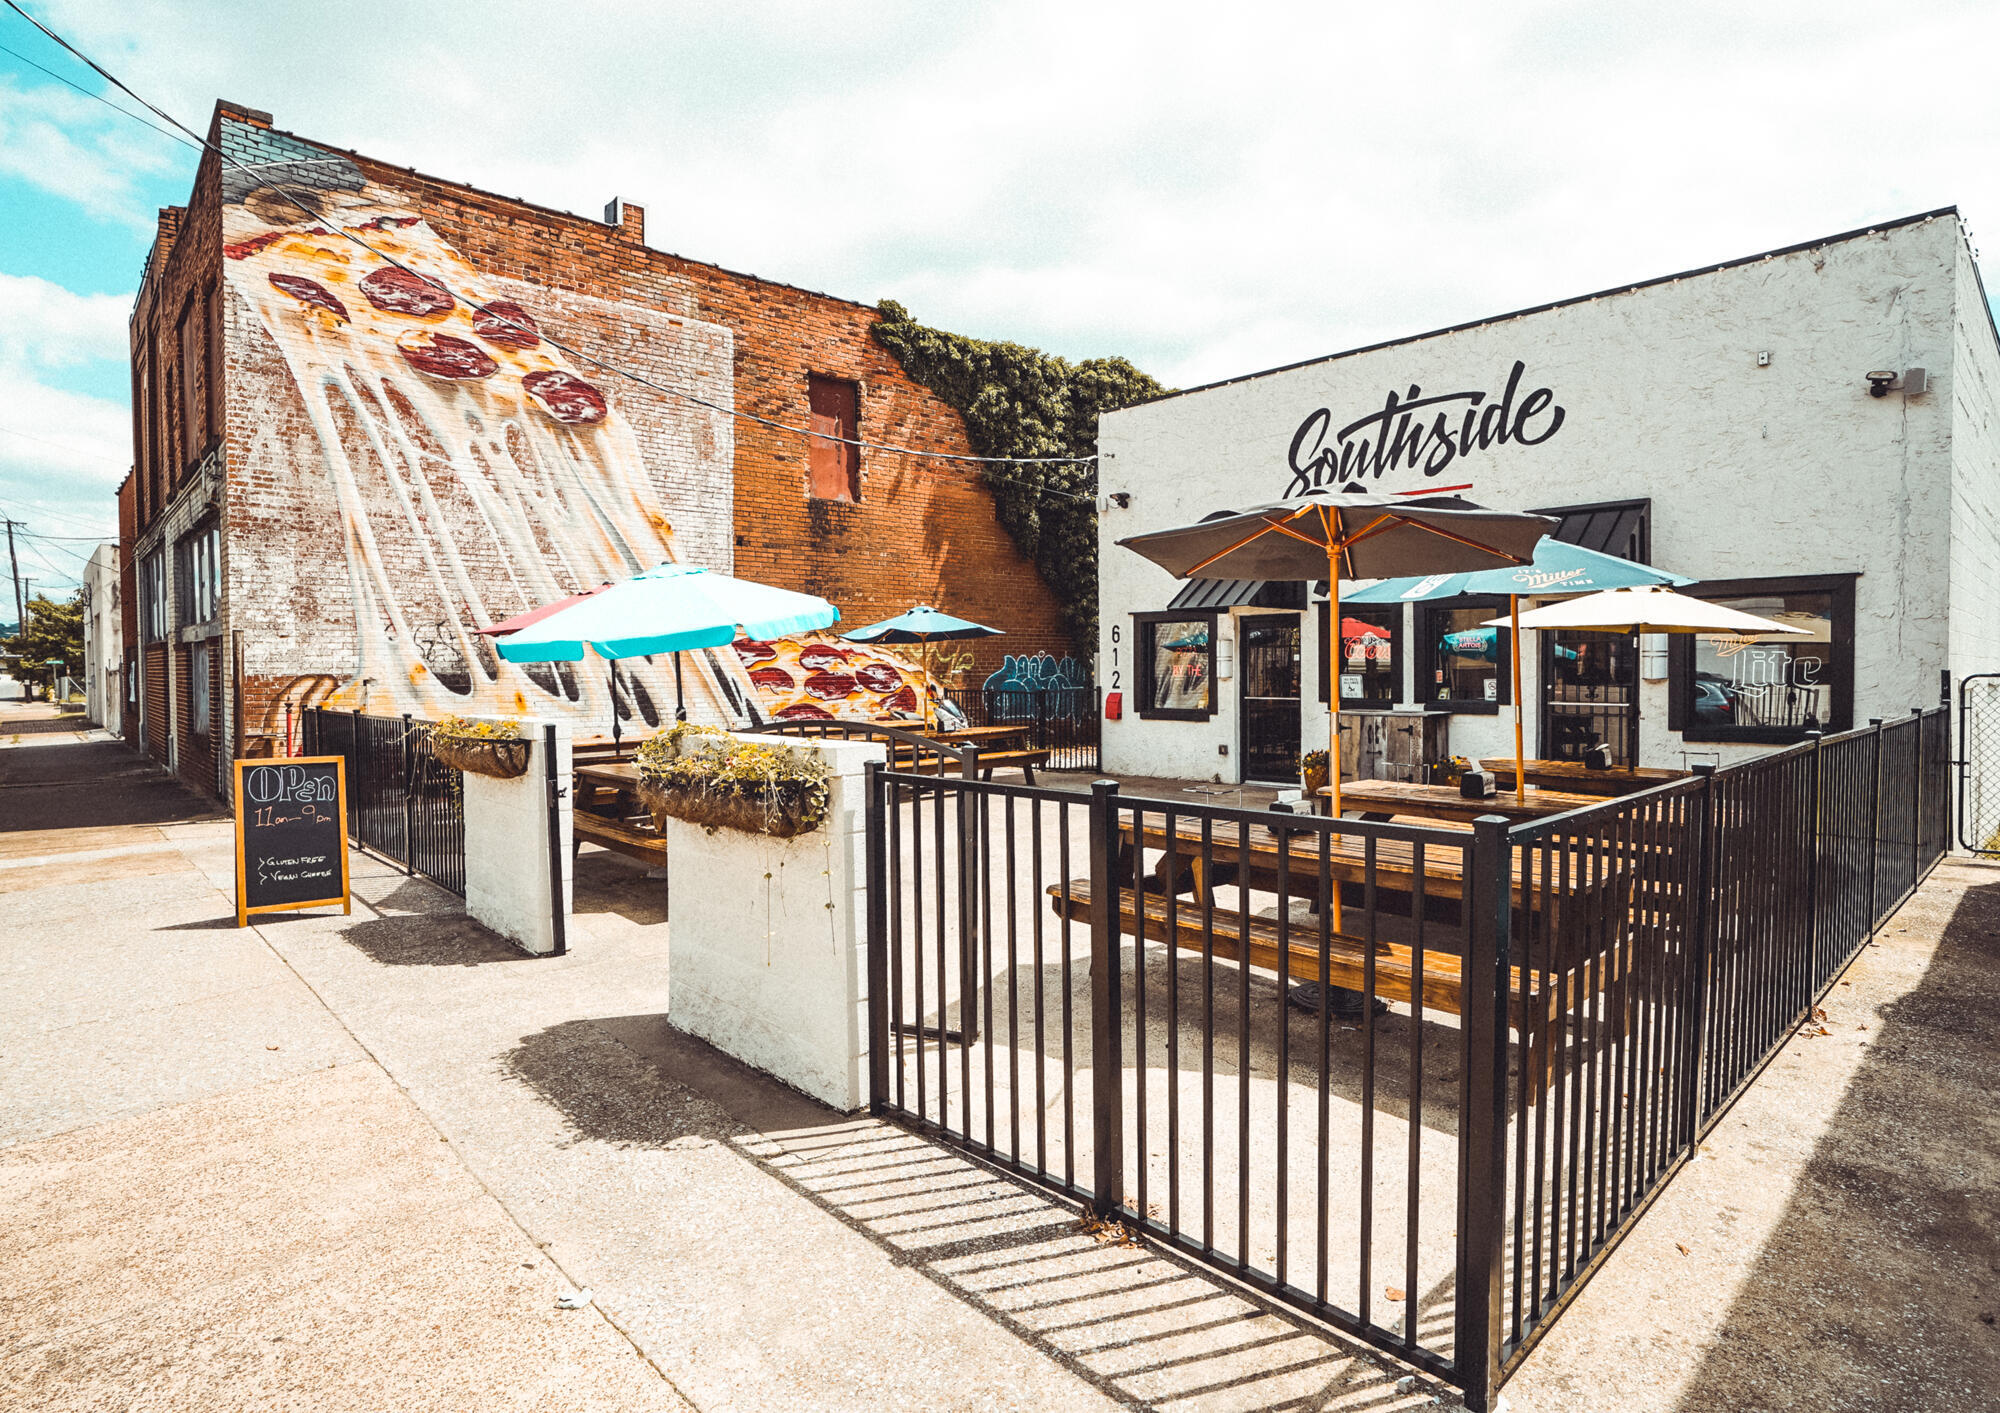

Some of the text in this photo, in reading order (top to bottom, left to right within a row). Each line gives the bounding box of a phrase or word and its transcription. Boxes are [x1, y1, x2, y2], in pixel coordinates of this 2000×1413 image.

[1283, 360, 1566, 499] Southside
[1512, 567, 1586, 589] Miller
[1560, 579, 1594, 587] TIME
[1111, 624, 1121, 689] 612
[1172, 664, 1203, 677] BY THE
[301, 855, 326, 863] FREE
